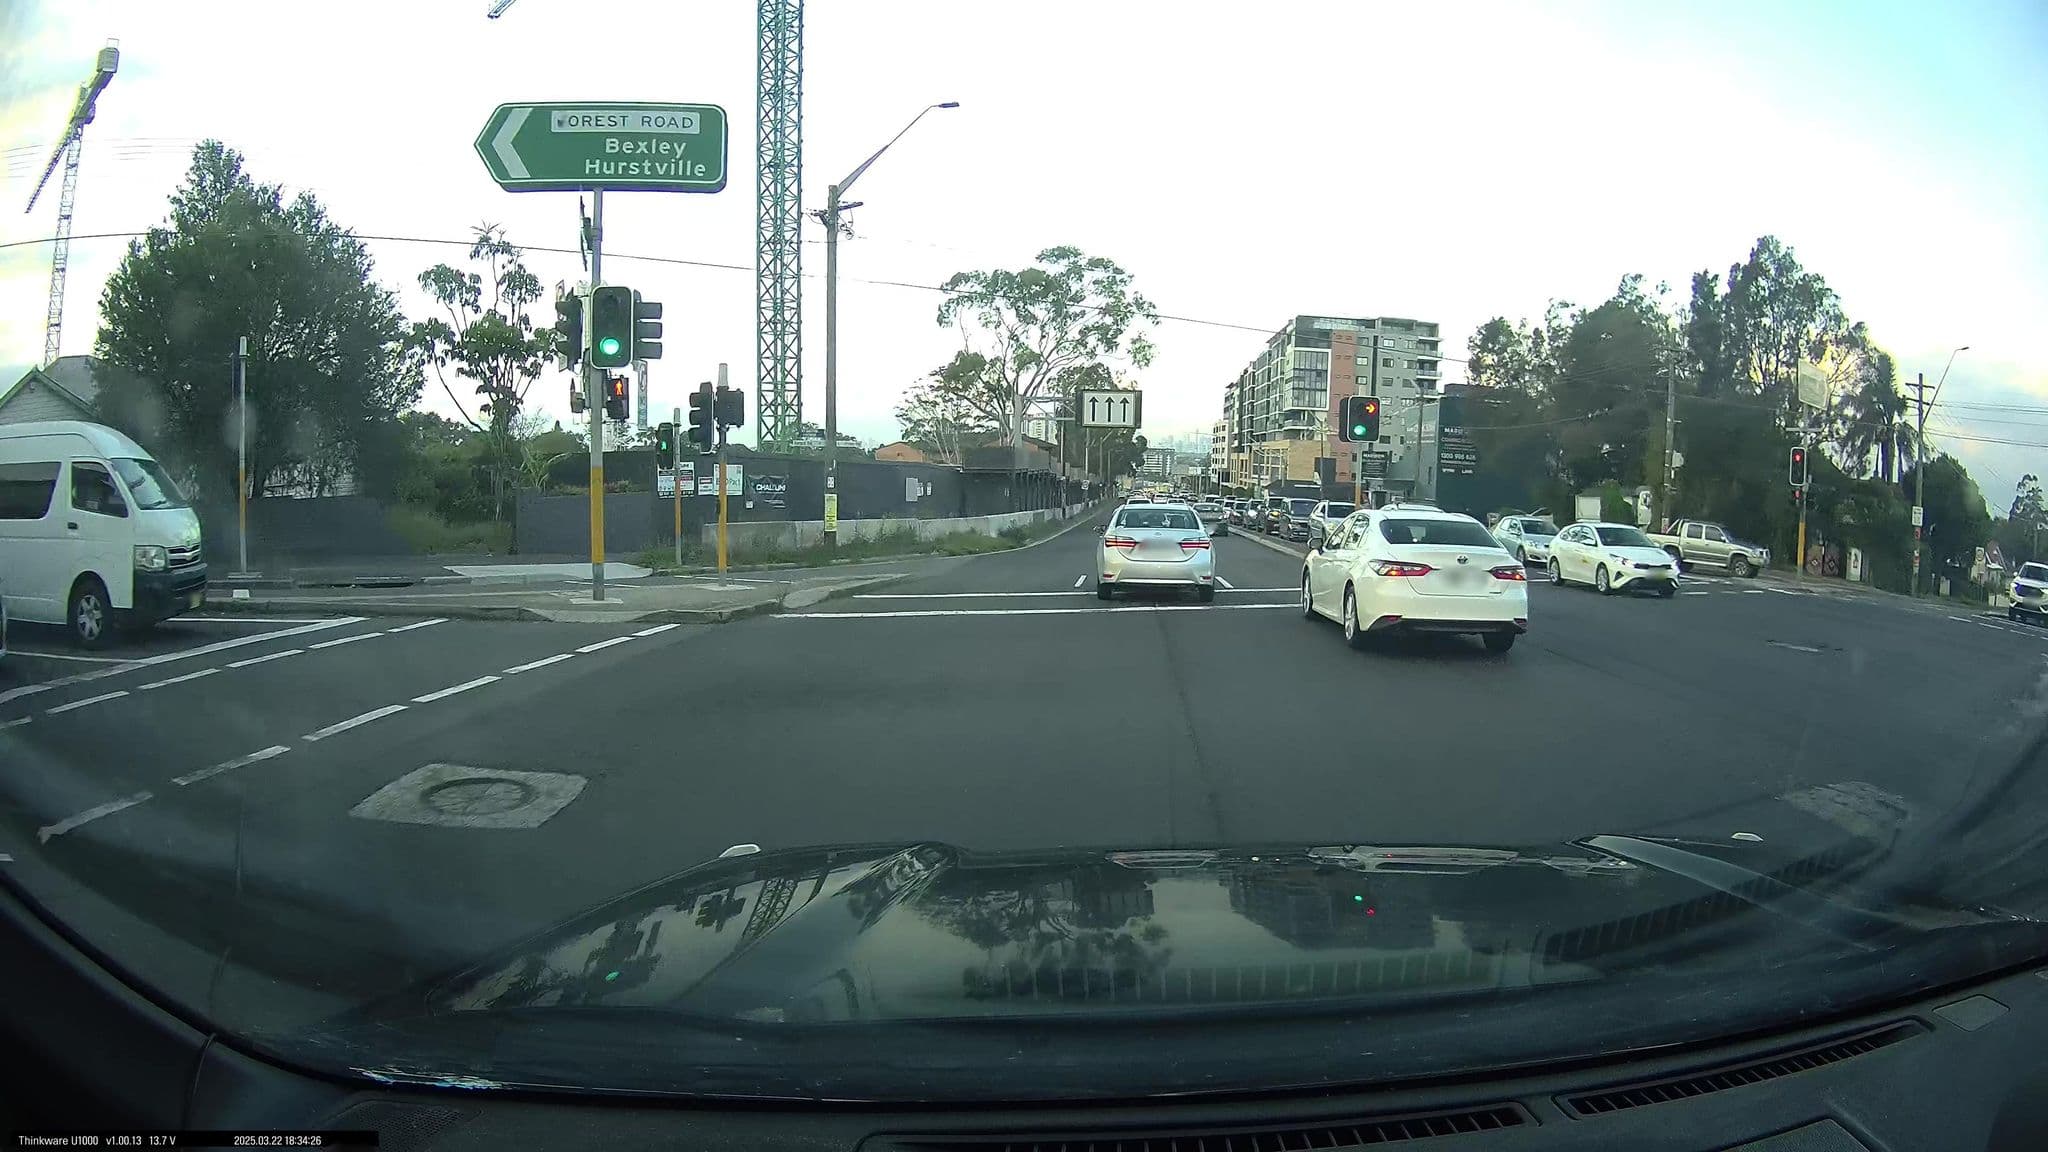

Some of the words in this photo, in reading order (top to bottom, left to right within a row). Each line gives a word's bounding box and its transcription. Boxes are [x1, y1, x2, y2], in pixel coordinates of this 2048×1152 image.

[641, 116, 694, 129] ROAD
[605, 138, 687, 159] Bexley
[585, 159, 706, 177] Hurstville
